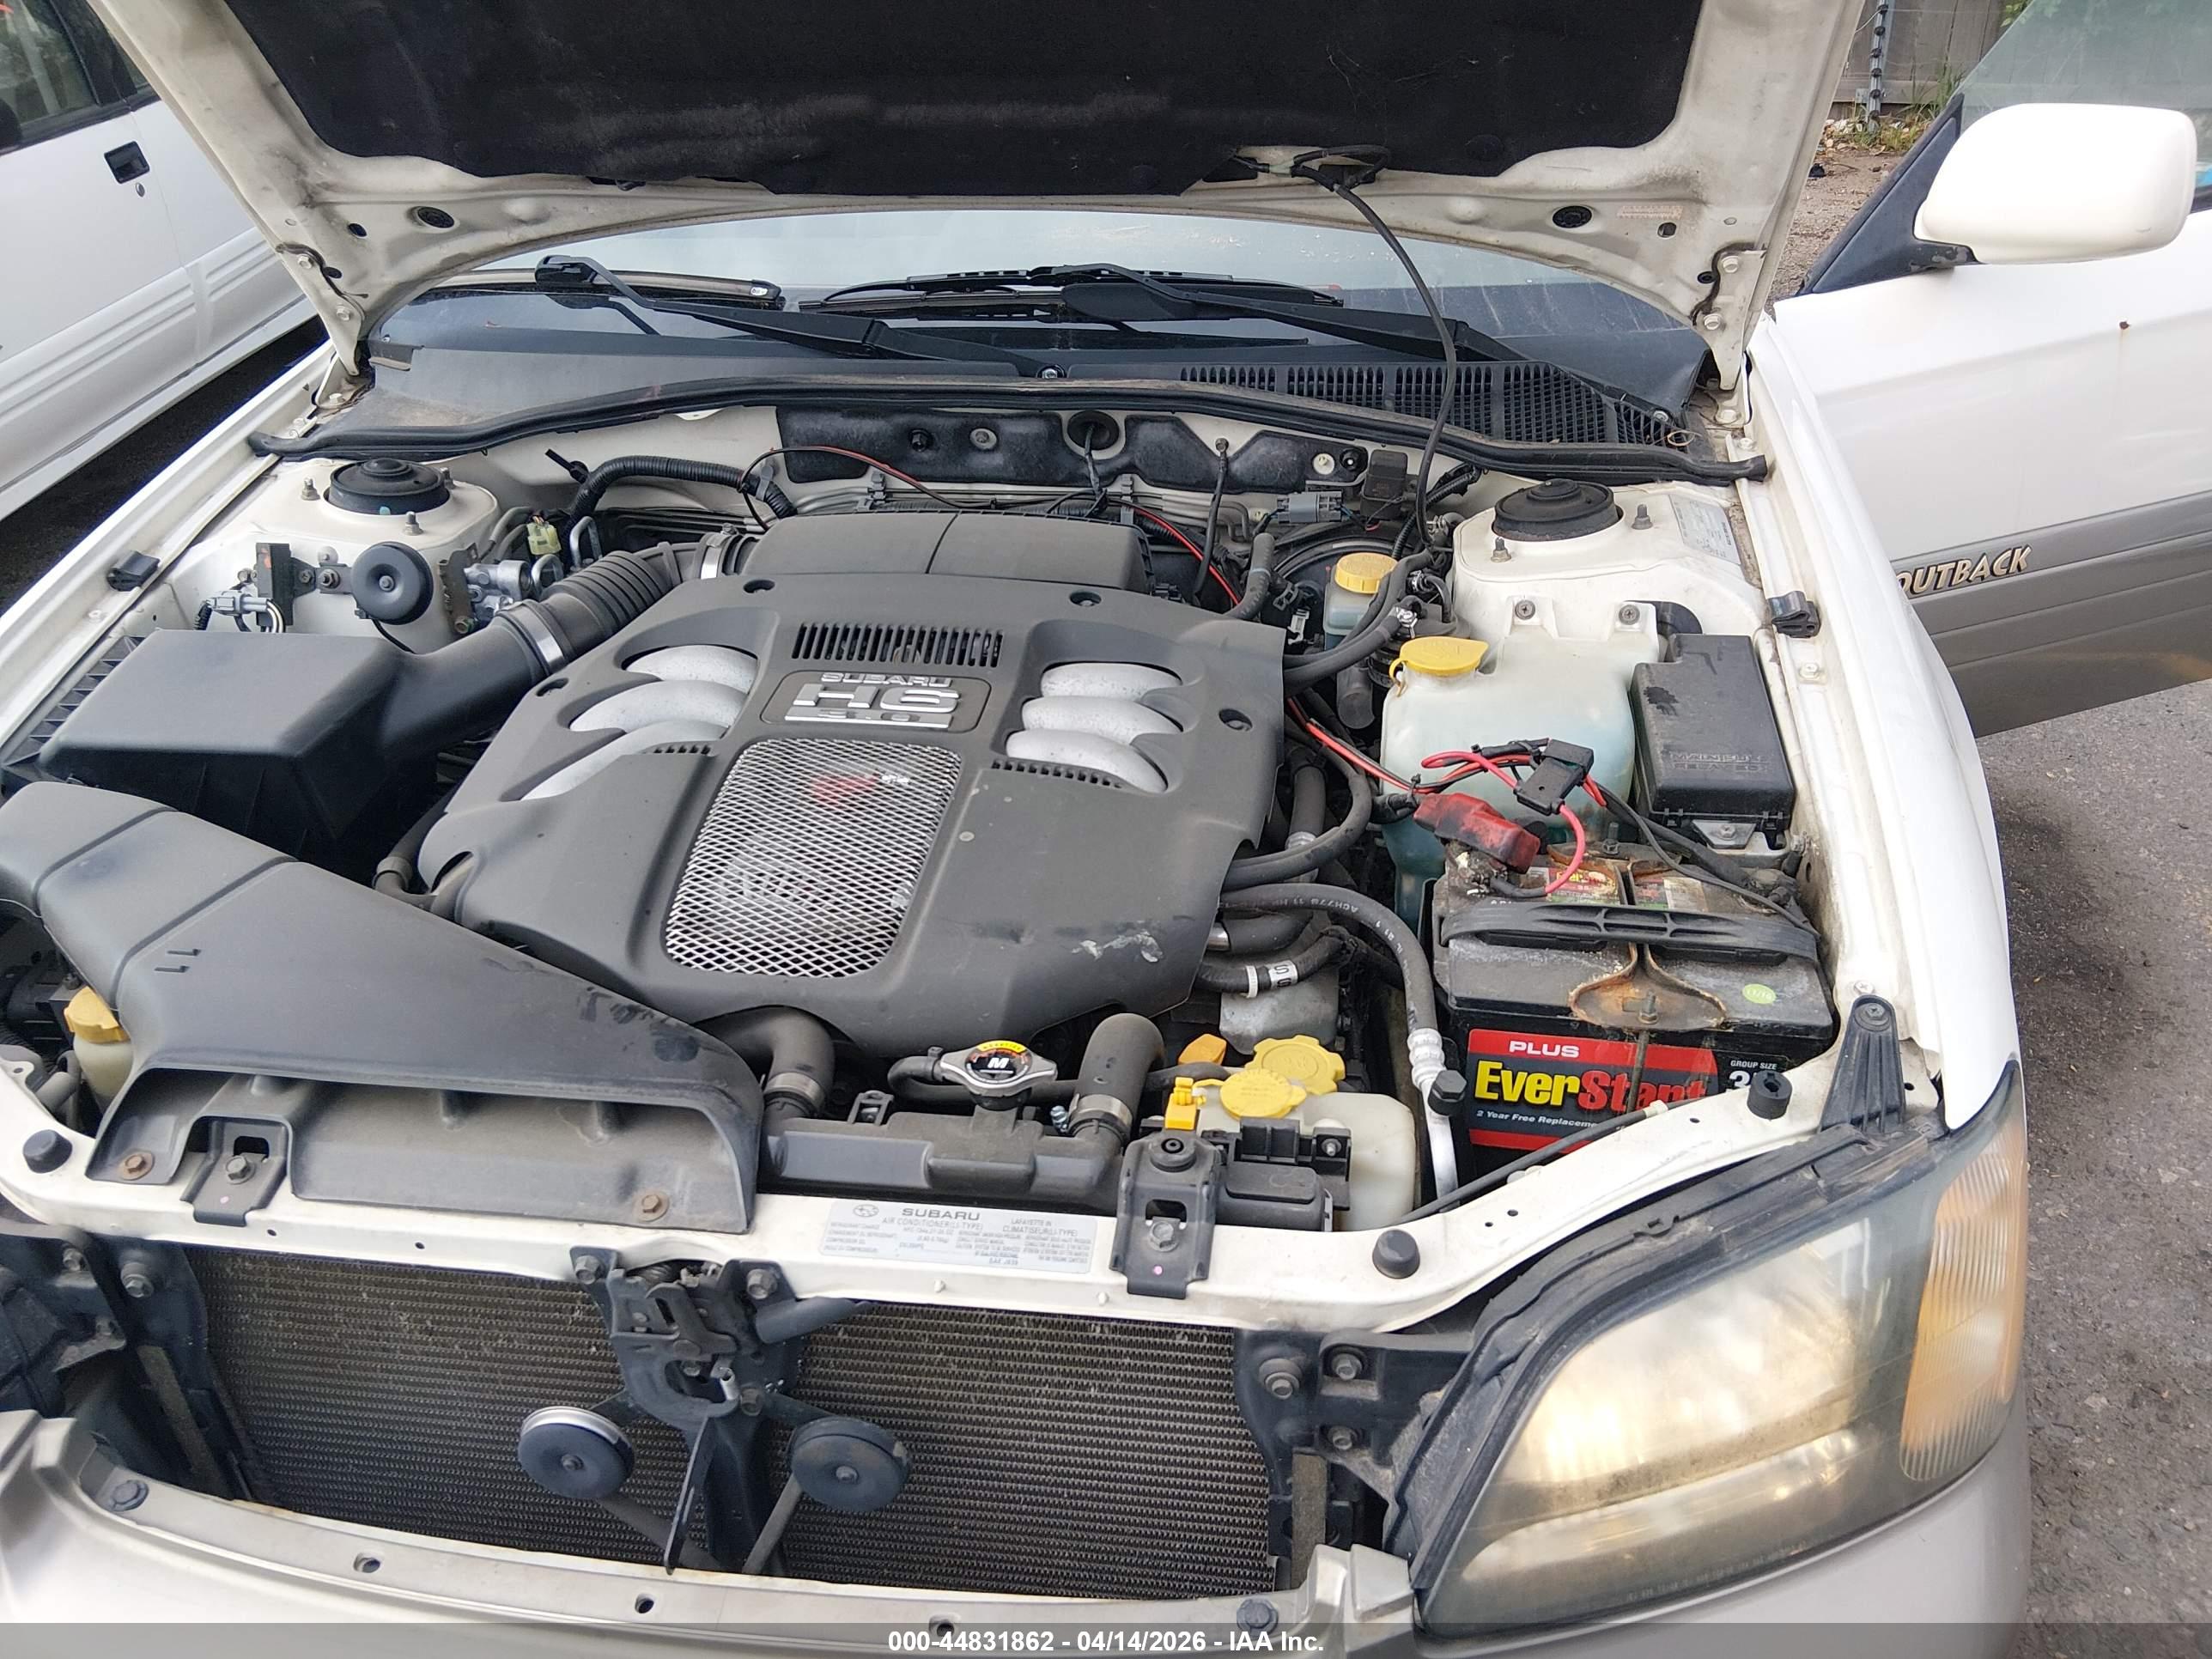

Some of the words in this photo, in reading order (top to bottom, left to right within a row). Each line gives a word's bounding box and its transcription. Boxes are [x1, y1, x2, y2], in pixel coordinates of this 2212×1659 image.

[1896, 544, 2032, 594] OUTBACK
[821, 672, 952, 687] SUBARU
[793, 684, 959, 713] H6
[1509, 1041, 1579, 1058] PLUS
[1730, 1060, 1759, 1069] GROUP
[1474, 1060, 1705, 1112] EverStart
[1487, 1111, 1510, 1120] Year
[1512, 1114, 1535, 1122] Free
[882, 1216, 896, 1224] AIR
[902, 1207, 981, 1221] SUBARU
